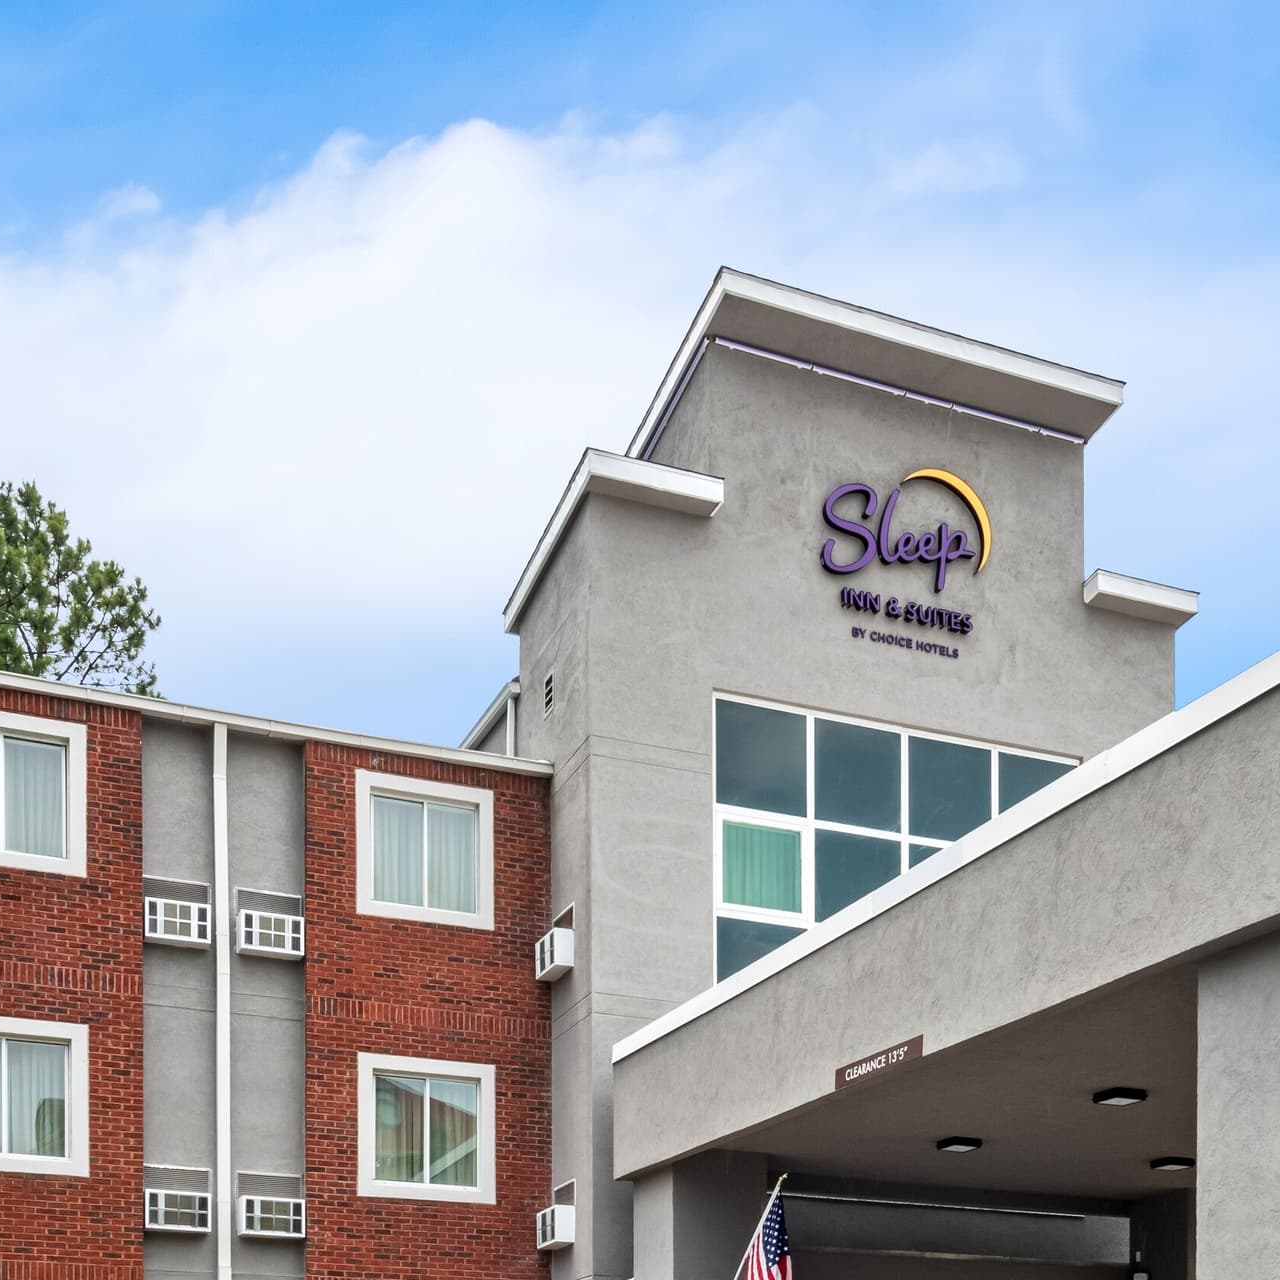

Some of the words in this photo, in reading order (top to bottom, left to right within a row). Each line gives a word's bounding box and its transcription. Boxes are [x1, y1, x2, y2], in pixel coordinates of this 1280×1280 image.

[822, 482, 976, 592] Sleep
[840, 586, 881, 614] INN
[885, 597, 901, 618] &
[903, 602, 974, 635] SUITES
[851, 626, 867, 640] BY
[869, 631, 913, 650] CHOICE
[915, 642, 959, 659] HOTELS
[845, 1054, 887, 1081] CLEARANCE
